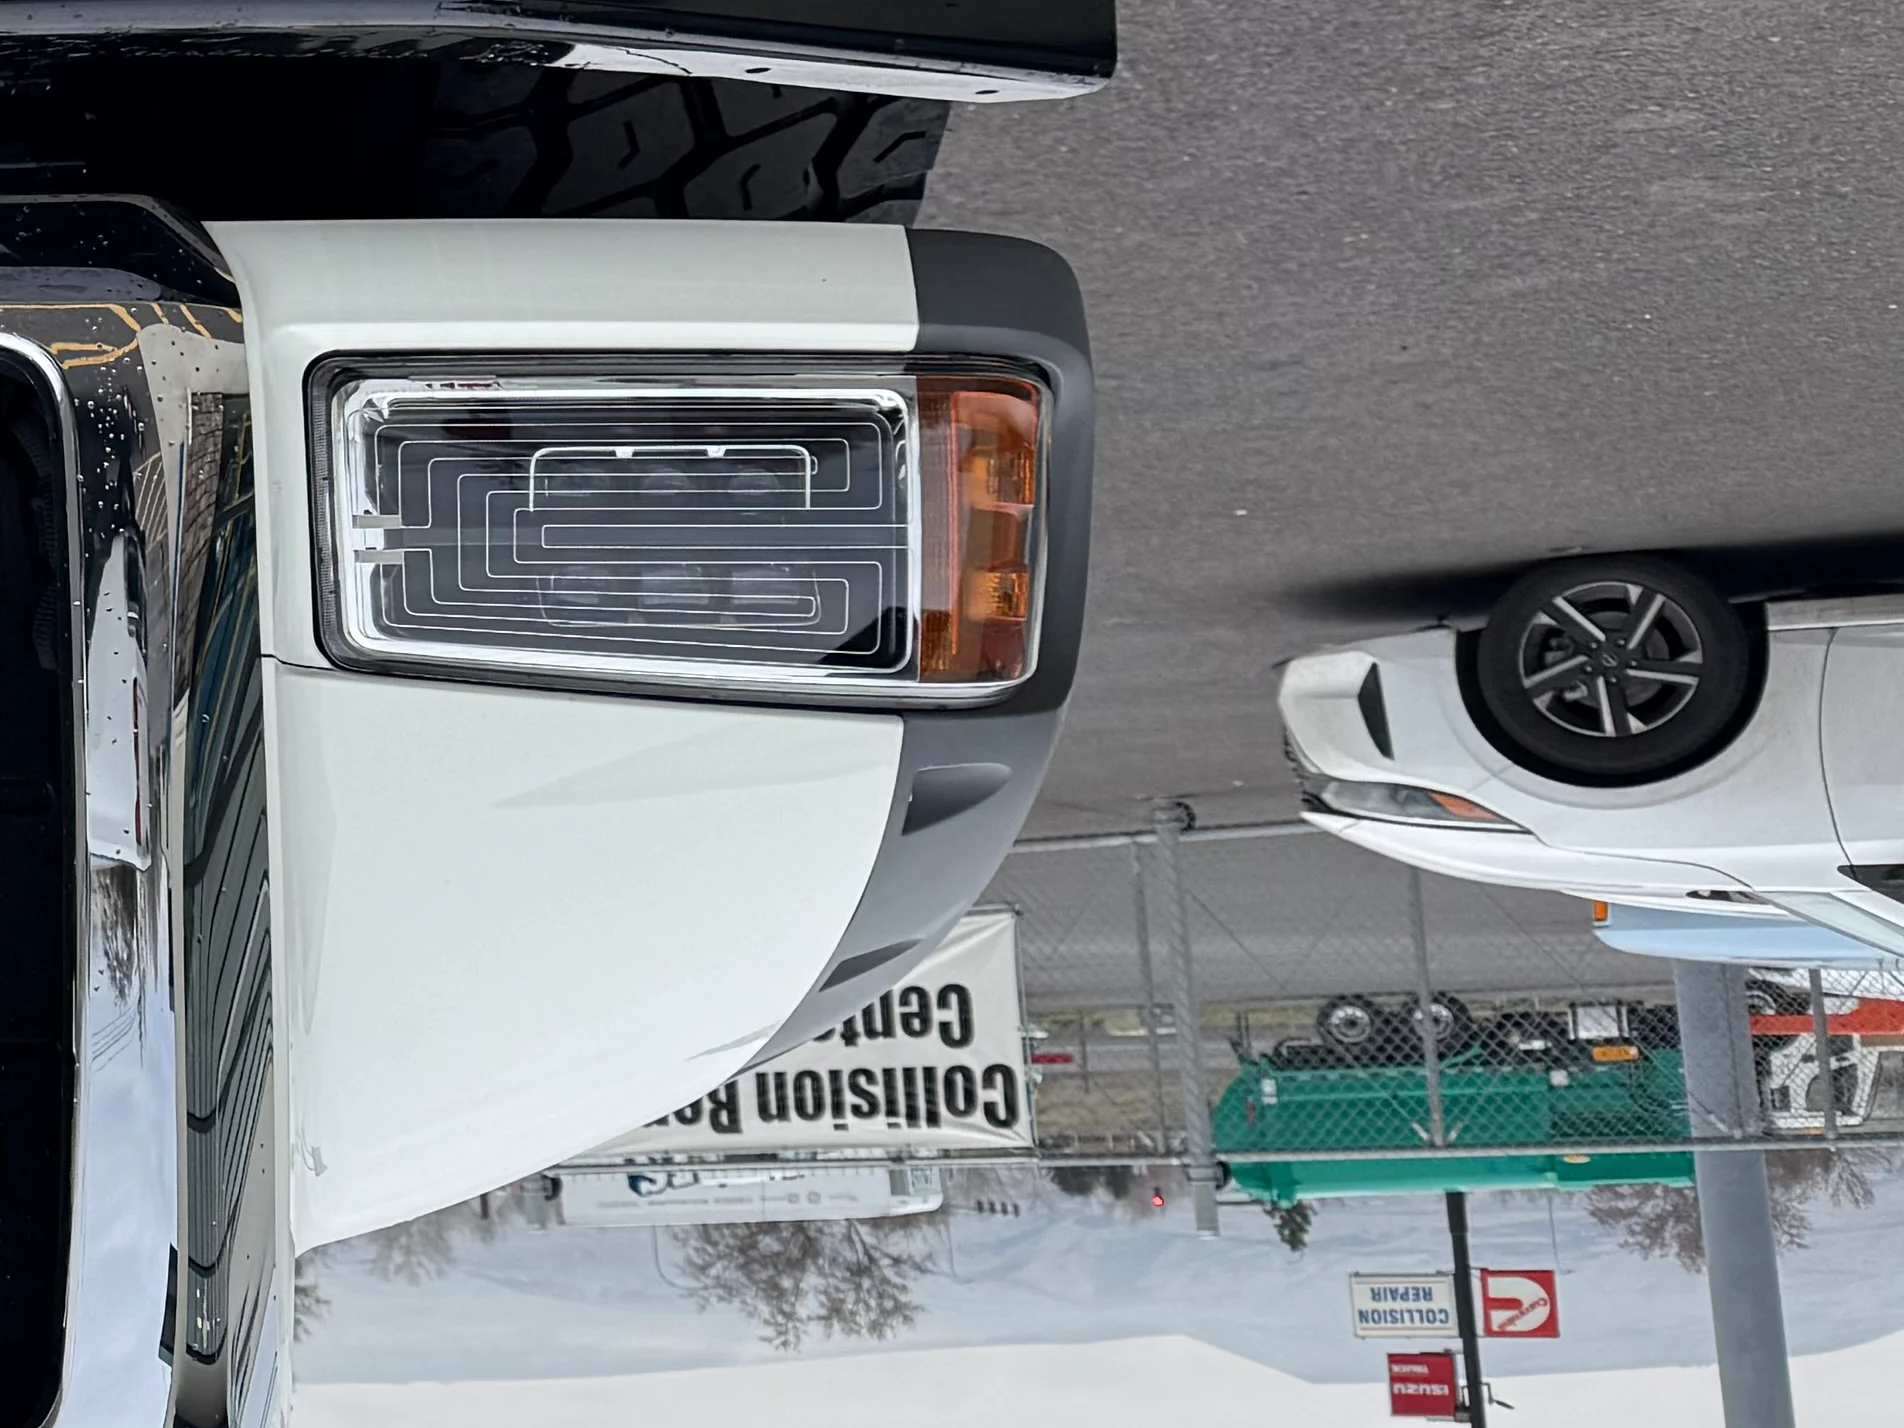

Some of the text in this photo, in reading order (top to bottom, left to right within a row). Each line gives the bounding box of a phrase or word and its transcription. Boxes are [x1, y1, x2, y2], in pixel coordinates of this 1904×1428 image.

[754, 1064, 1019, 1132] Collision
[1370, 1286, 1433, 1302] REPAIR
[1357, 1308, 1449, 1325] COLLISION
[1393, 1383, 1450, 1396] ISUZU
